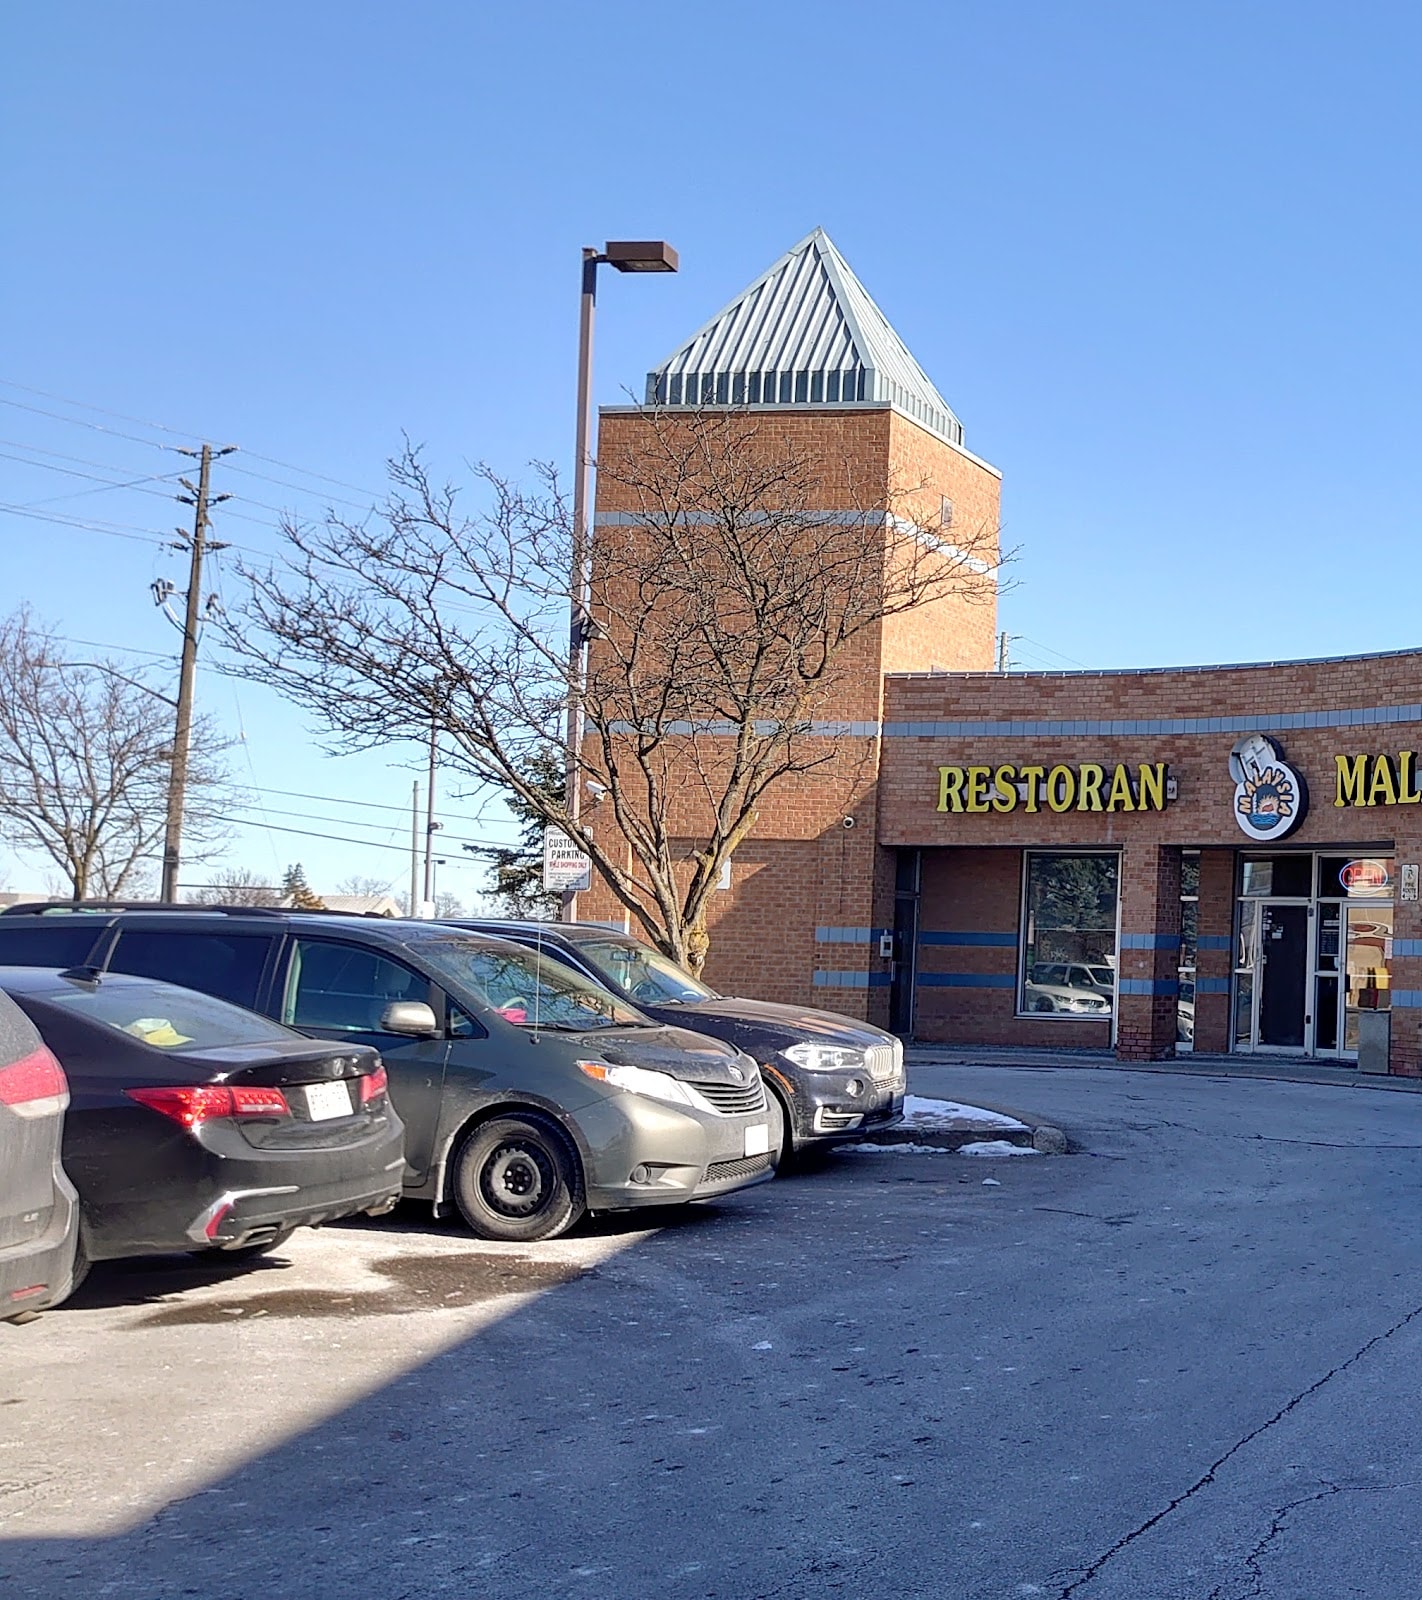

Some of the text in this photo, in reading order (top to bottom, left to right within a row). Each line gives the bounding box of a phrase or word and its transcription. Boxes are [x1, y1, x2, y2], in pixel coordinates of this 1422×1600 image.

[935, 761, 1166, 813] RESTORAN
[1237, 765, 1294, 818] MALAYSIA
[551, 850, 585, 860] PARKING
[1342, 867, 1382, 886] OPEN
